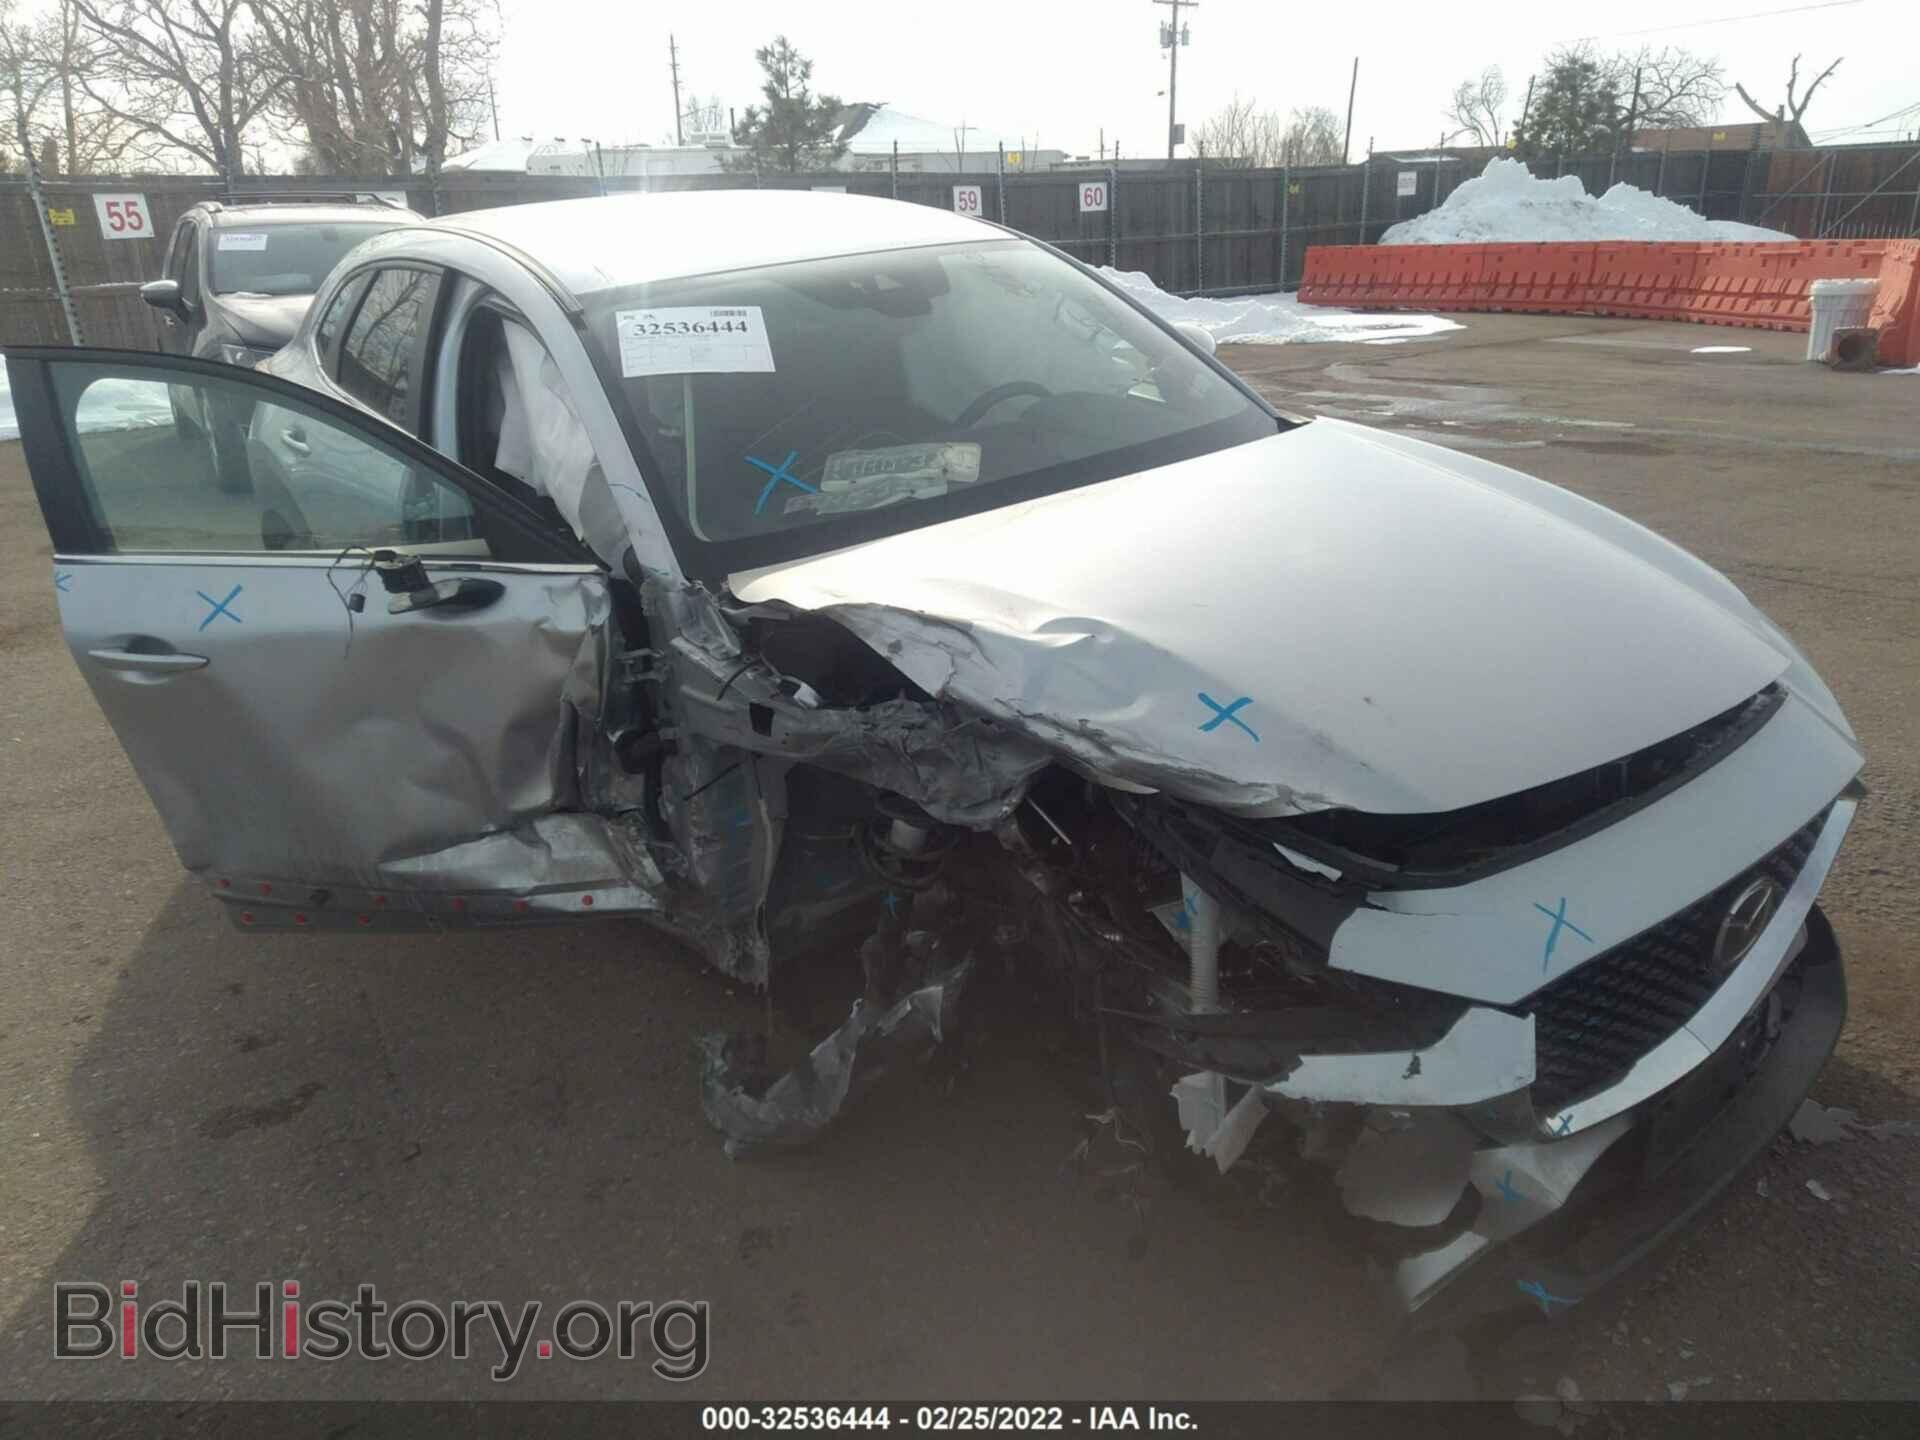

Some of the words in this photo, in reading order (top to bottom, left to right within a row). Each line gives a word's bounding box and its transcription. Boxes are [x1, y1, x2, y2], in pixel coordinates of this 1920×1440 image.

[958, 191, 978, 211] 59
[1083, 187, 1103, 207] 60
[105, 201, 144, 232] 55
[633, 320, 748, 336] 32536444
